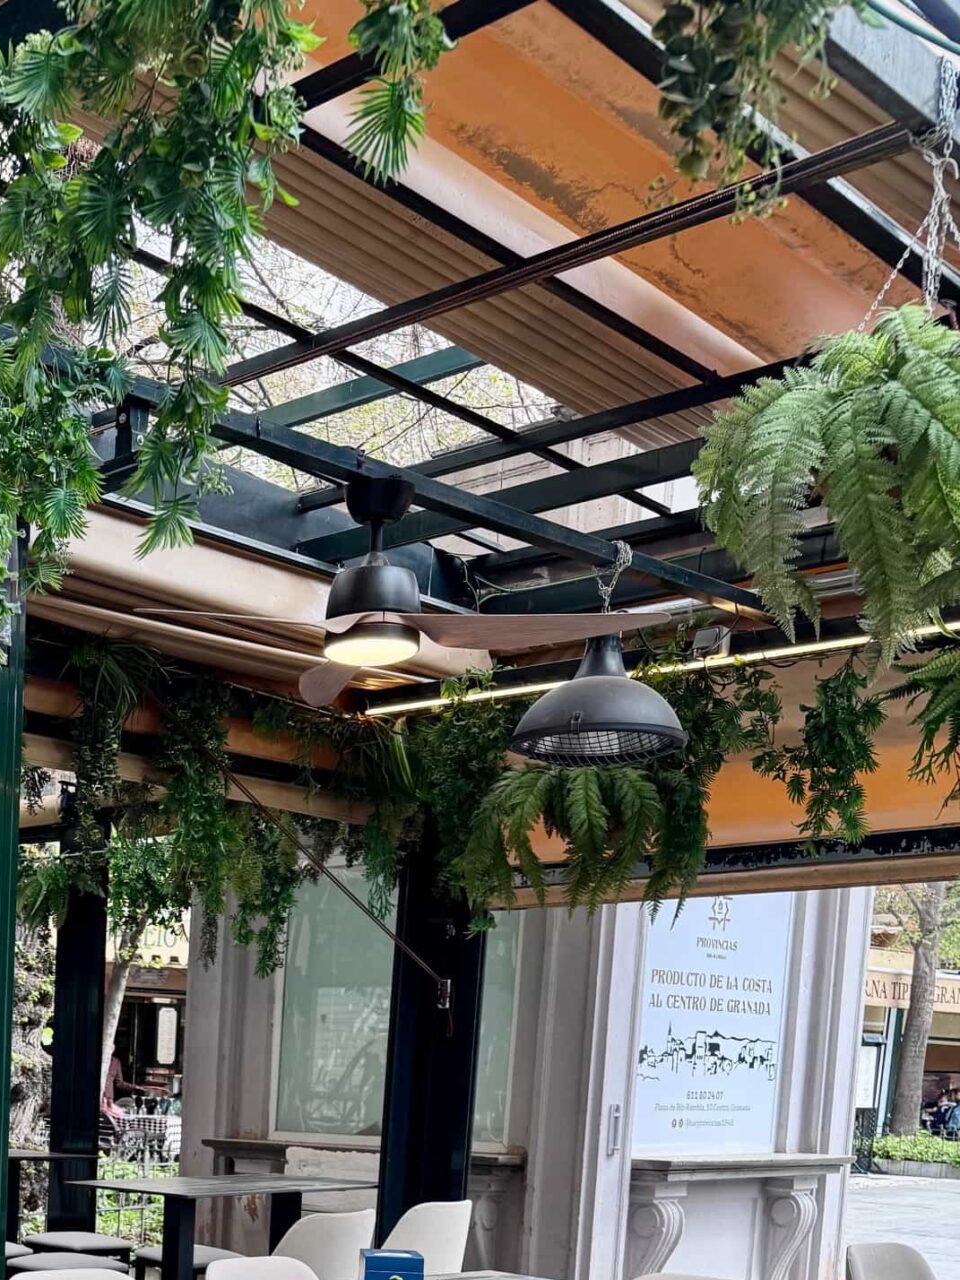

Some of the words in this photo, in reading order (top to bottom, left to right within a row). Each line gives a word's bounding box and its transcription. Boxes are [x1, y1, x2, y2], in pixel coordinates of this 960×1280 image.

[696, 936, 738, 951] PROVINCIAS
[651, 968, 706, 988] PRODUCTO
[709, 974, 724, 989] DE
[726, 976, 739, 991] LA
[742, 977, 773, 994] COSTA
[649, 993, 663, 1008] AL
[666, 994, 707, 1011] CENTRO
[709, 998, 724, 1012] DE
[726, 999, 771, 1016] GRANADA
